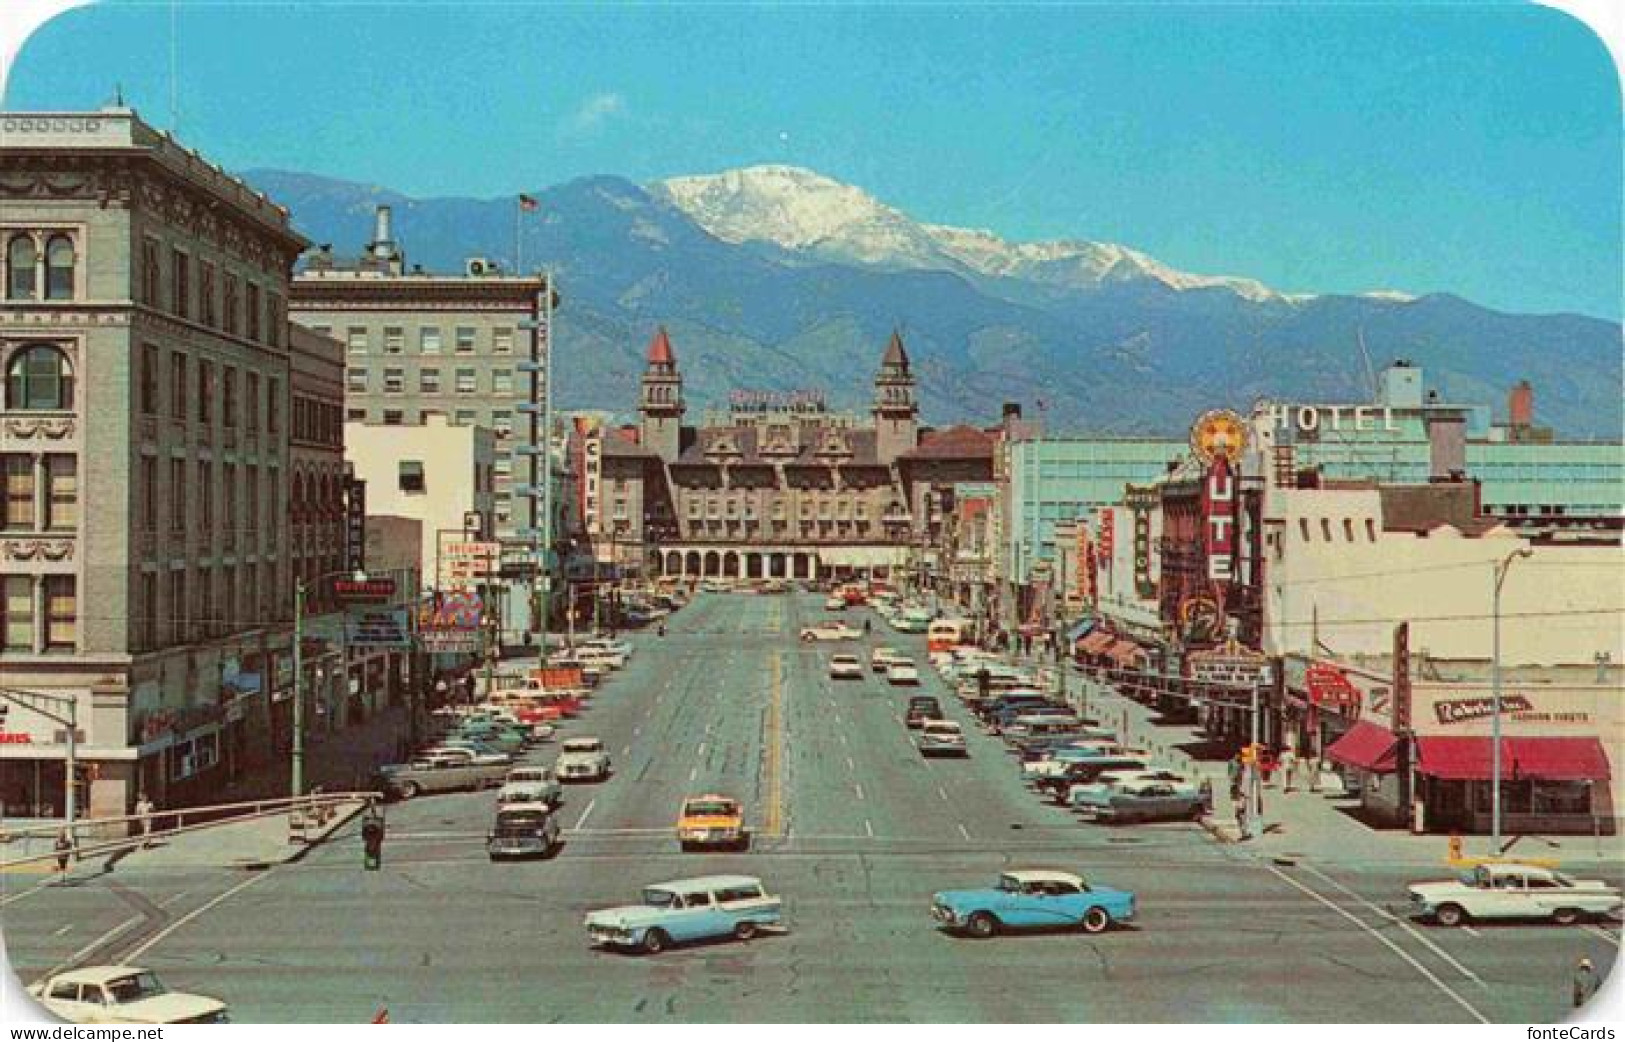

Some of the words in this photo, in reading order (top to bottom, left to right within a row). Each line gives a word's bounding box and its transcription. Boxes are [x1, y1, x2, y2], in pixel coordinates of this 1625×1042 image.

[1269, 403, 1401, 430] HOTEL
[586, 442, 598, 526] CHIEF
[1208, 475, 1233, 580] UTE
